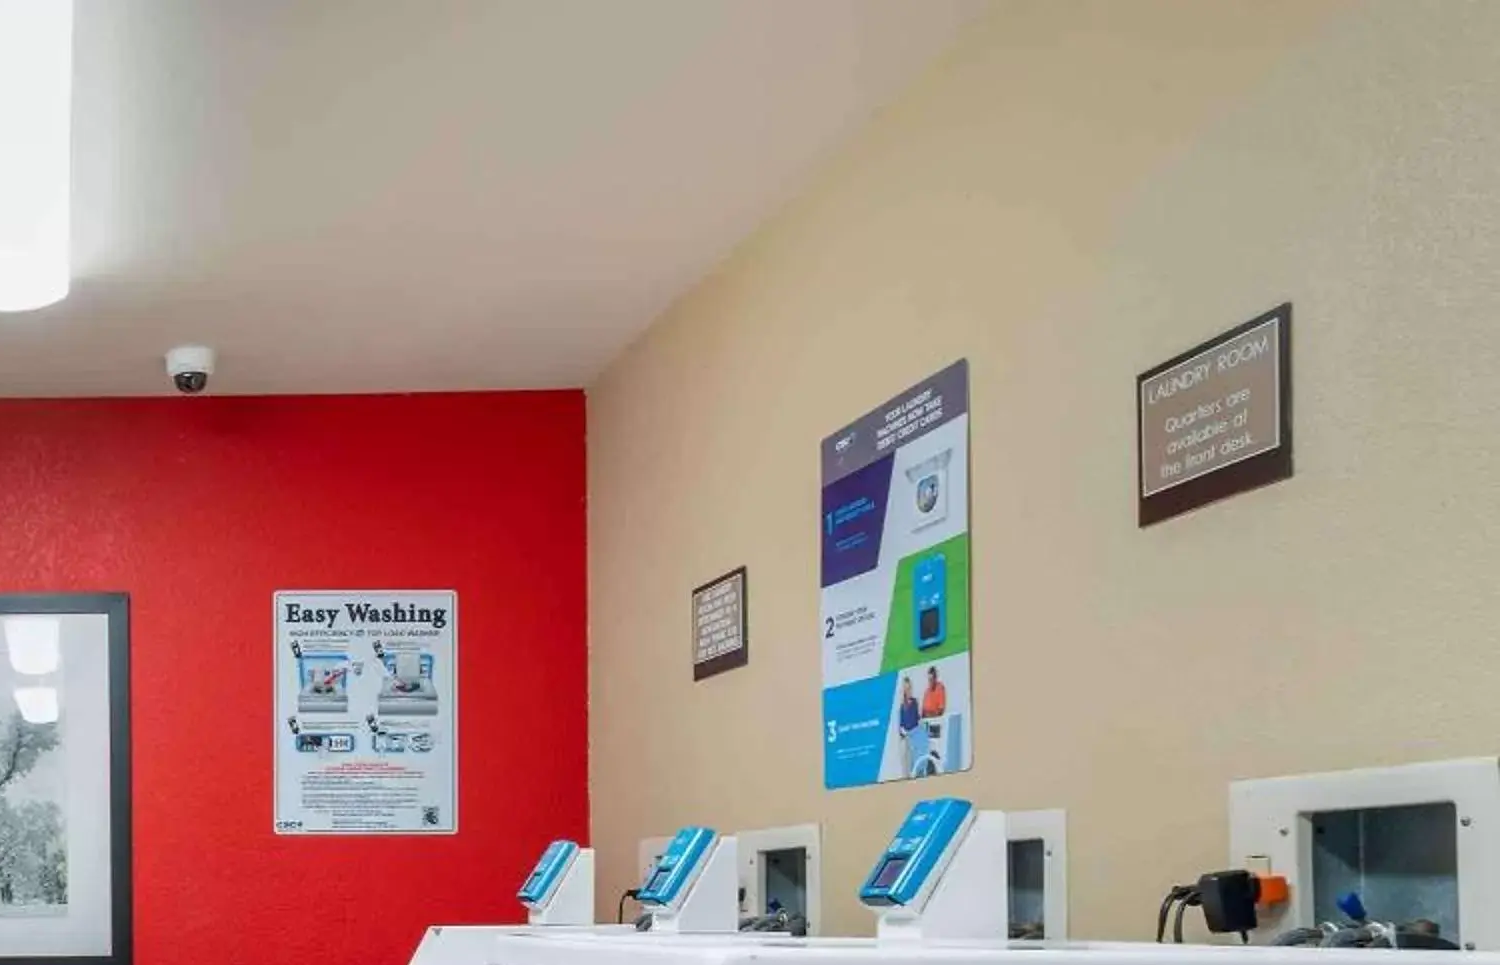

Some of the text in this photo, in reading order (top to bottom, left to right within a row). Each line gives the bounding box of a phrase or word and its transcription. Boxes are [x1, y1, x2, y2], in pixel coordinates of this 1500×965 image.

[1148, 335, 1269, 404] LAUNDRY ROOM
[1164, 387, 1250, 433] Quarters are
[1167, 408, 1248, 455] available at
[1160, 433, 1253, 479] the front desk
[285, 602, 447, 629] Easy Washing
[825, 616, 835, 639] 2
[827, 719, 837, 743] 3
